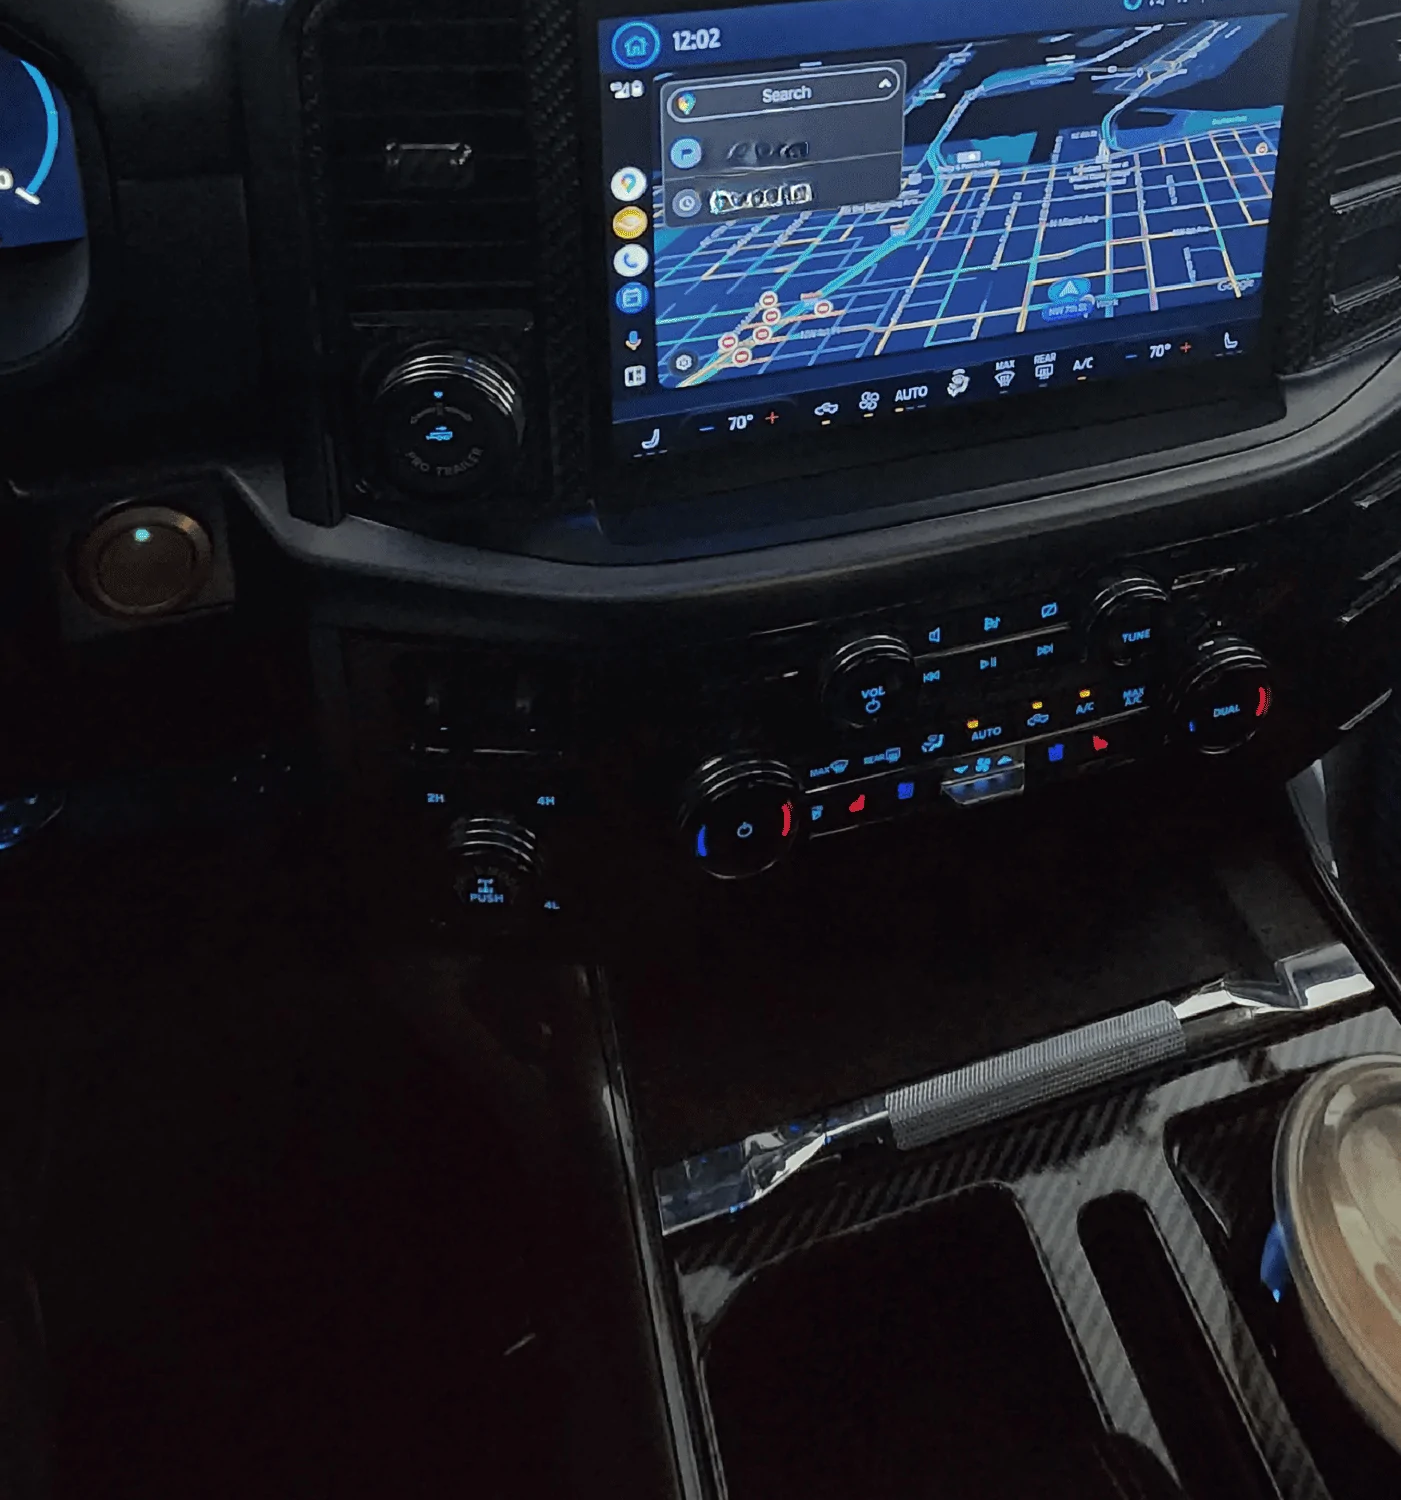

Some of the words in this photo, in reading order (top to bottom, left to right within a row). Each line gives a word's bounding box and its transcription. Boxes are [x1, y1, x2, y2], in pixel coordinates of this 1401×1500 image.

[672, 27, 721, 52] 12:02
[762, 85, 813, 104] Search
[995, 358, 1015, 371] MAX
[1033, 352, 1057, 364] REAR
[1072, 357, 1094, 372] A/C
[894, 386, 928, 402] AUTO
[405, 451, 430, 472] PRO
[436, 447, 484, 477] TRAILER
[1122, 628, 1151, 643] TUNE
[861, 686, 886, 700] VOL
[1122, 687, 1146, 699] MAX
[1075, 702, 1095, 715] A/C
[1213, 704, 1241, 718] DUAL
[971, 726, 1002, 742] AUTO
[809, 766, 831, 778] MAX
[427, 792, 445, 803] 2H
[536, 796, 556, 806] 4H
[469, 893, 504, 904] PUSH
